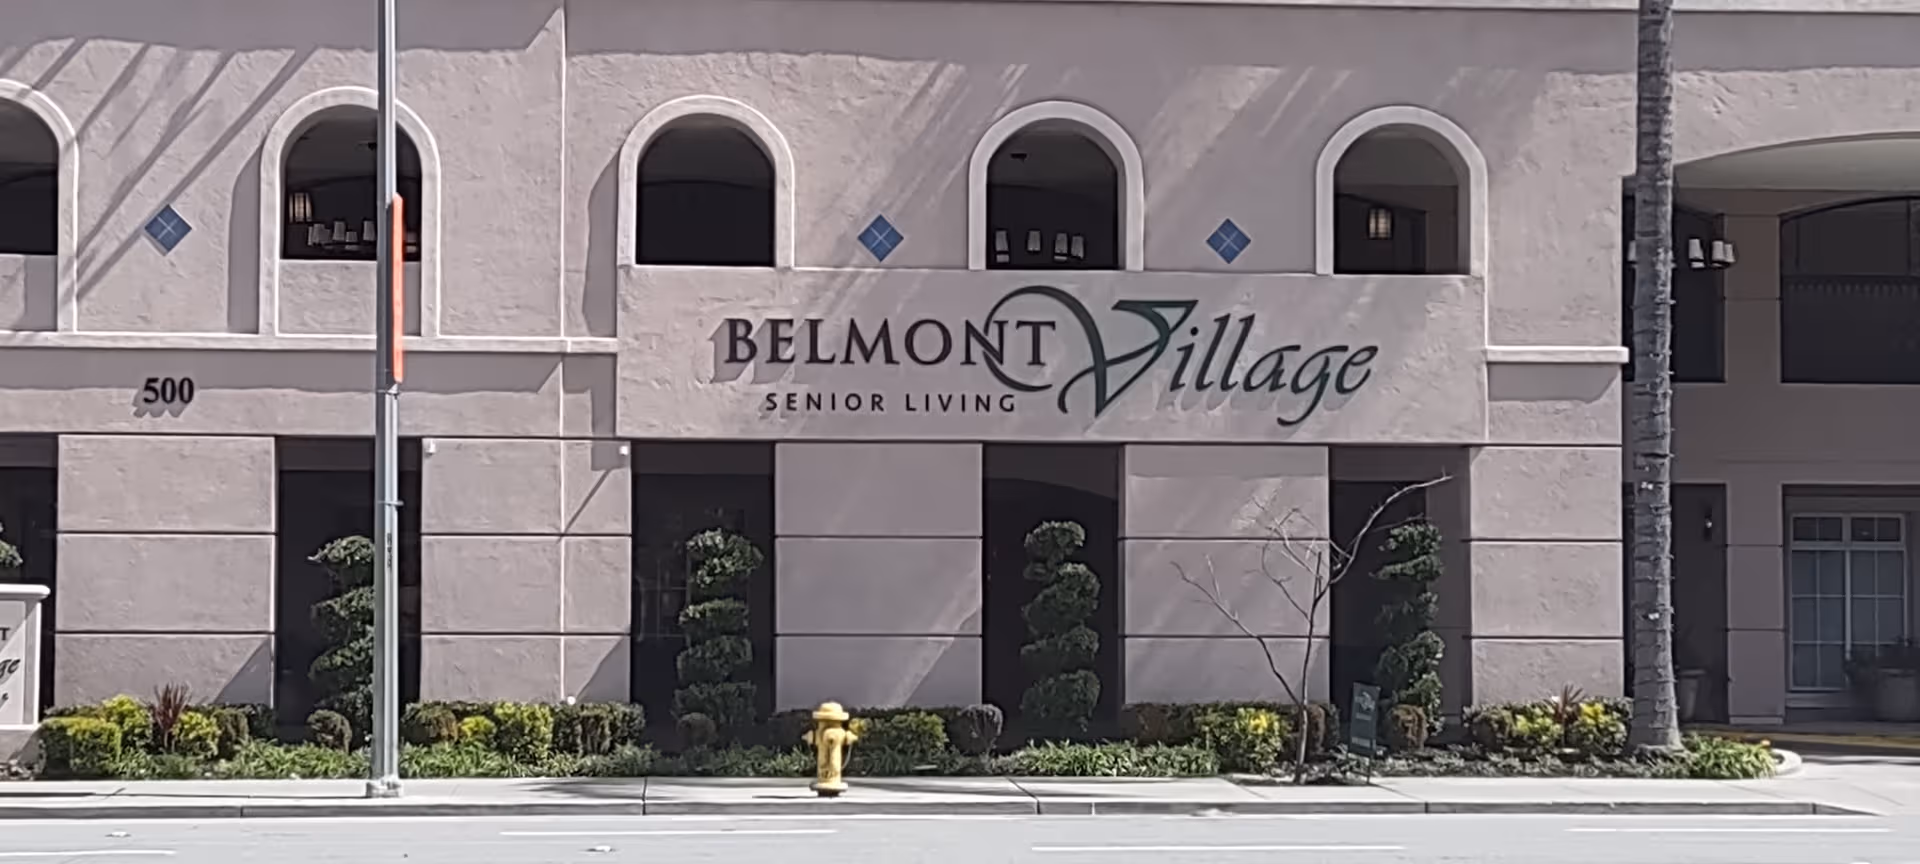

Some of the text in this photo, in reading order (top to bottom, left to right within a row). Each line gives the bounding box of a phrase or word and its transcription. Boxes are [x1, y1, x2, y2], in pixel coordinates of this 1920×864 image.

[724, 299, 1378, 426] BELMONT Village
[143, 377, 194, 404] 500
[765, 392, 1015, 412] SENIOR LIVING
